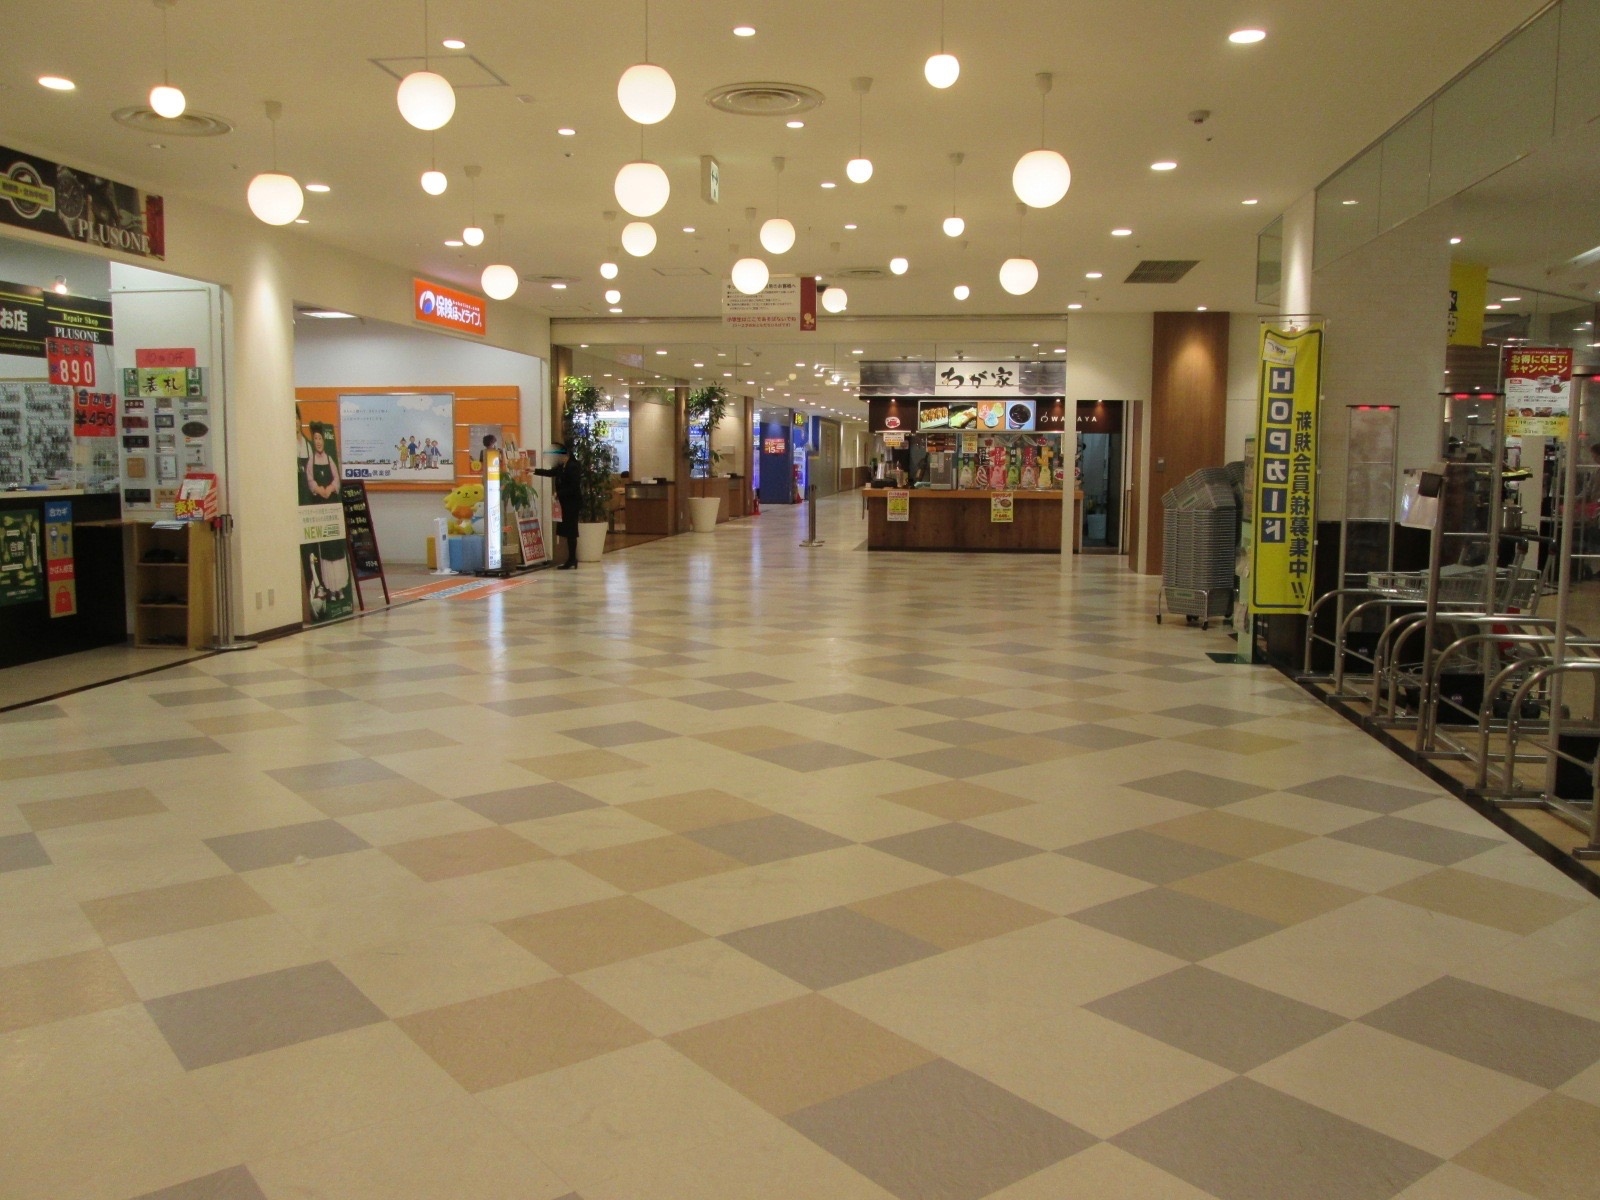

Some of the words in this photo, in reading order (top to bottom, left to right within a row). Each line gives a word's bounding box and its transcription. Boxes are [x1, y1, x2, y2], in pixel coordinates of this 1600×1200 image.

[78, 218, 150, 252] PLUSONE
[63, 313, 82, 323] Repair
[84, 317, 99, 326] Shop
[54, 326, 100, 343] PLUSONE
[1511, 354, 1568, 364] お得にGET!
[941, 366, 1014, 389] わが家
[1510, 365, 1568, 374] キャンペーン
[142, 376, 180, 393] 表札
[75, 409, 114, 426] ¥450
[304, 526, 322, 540] NEW
